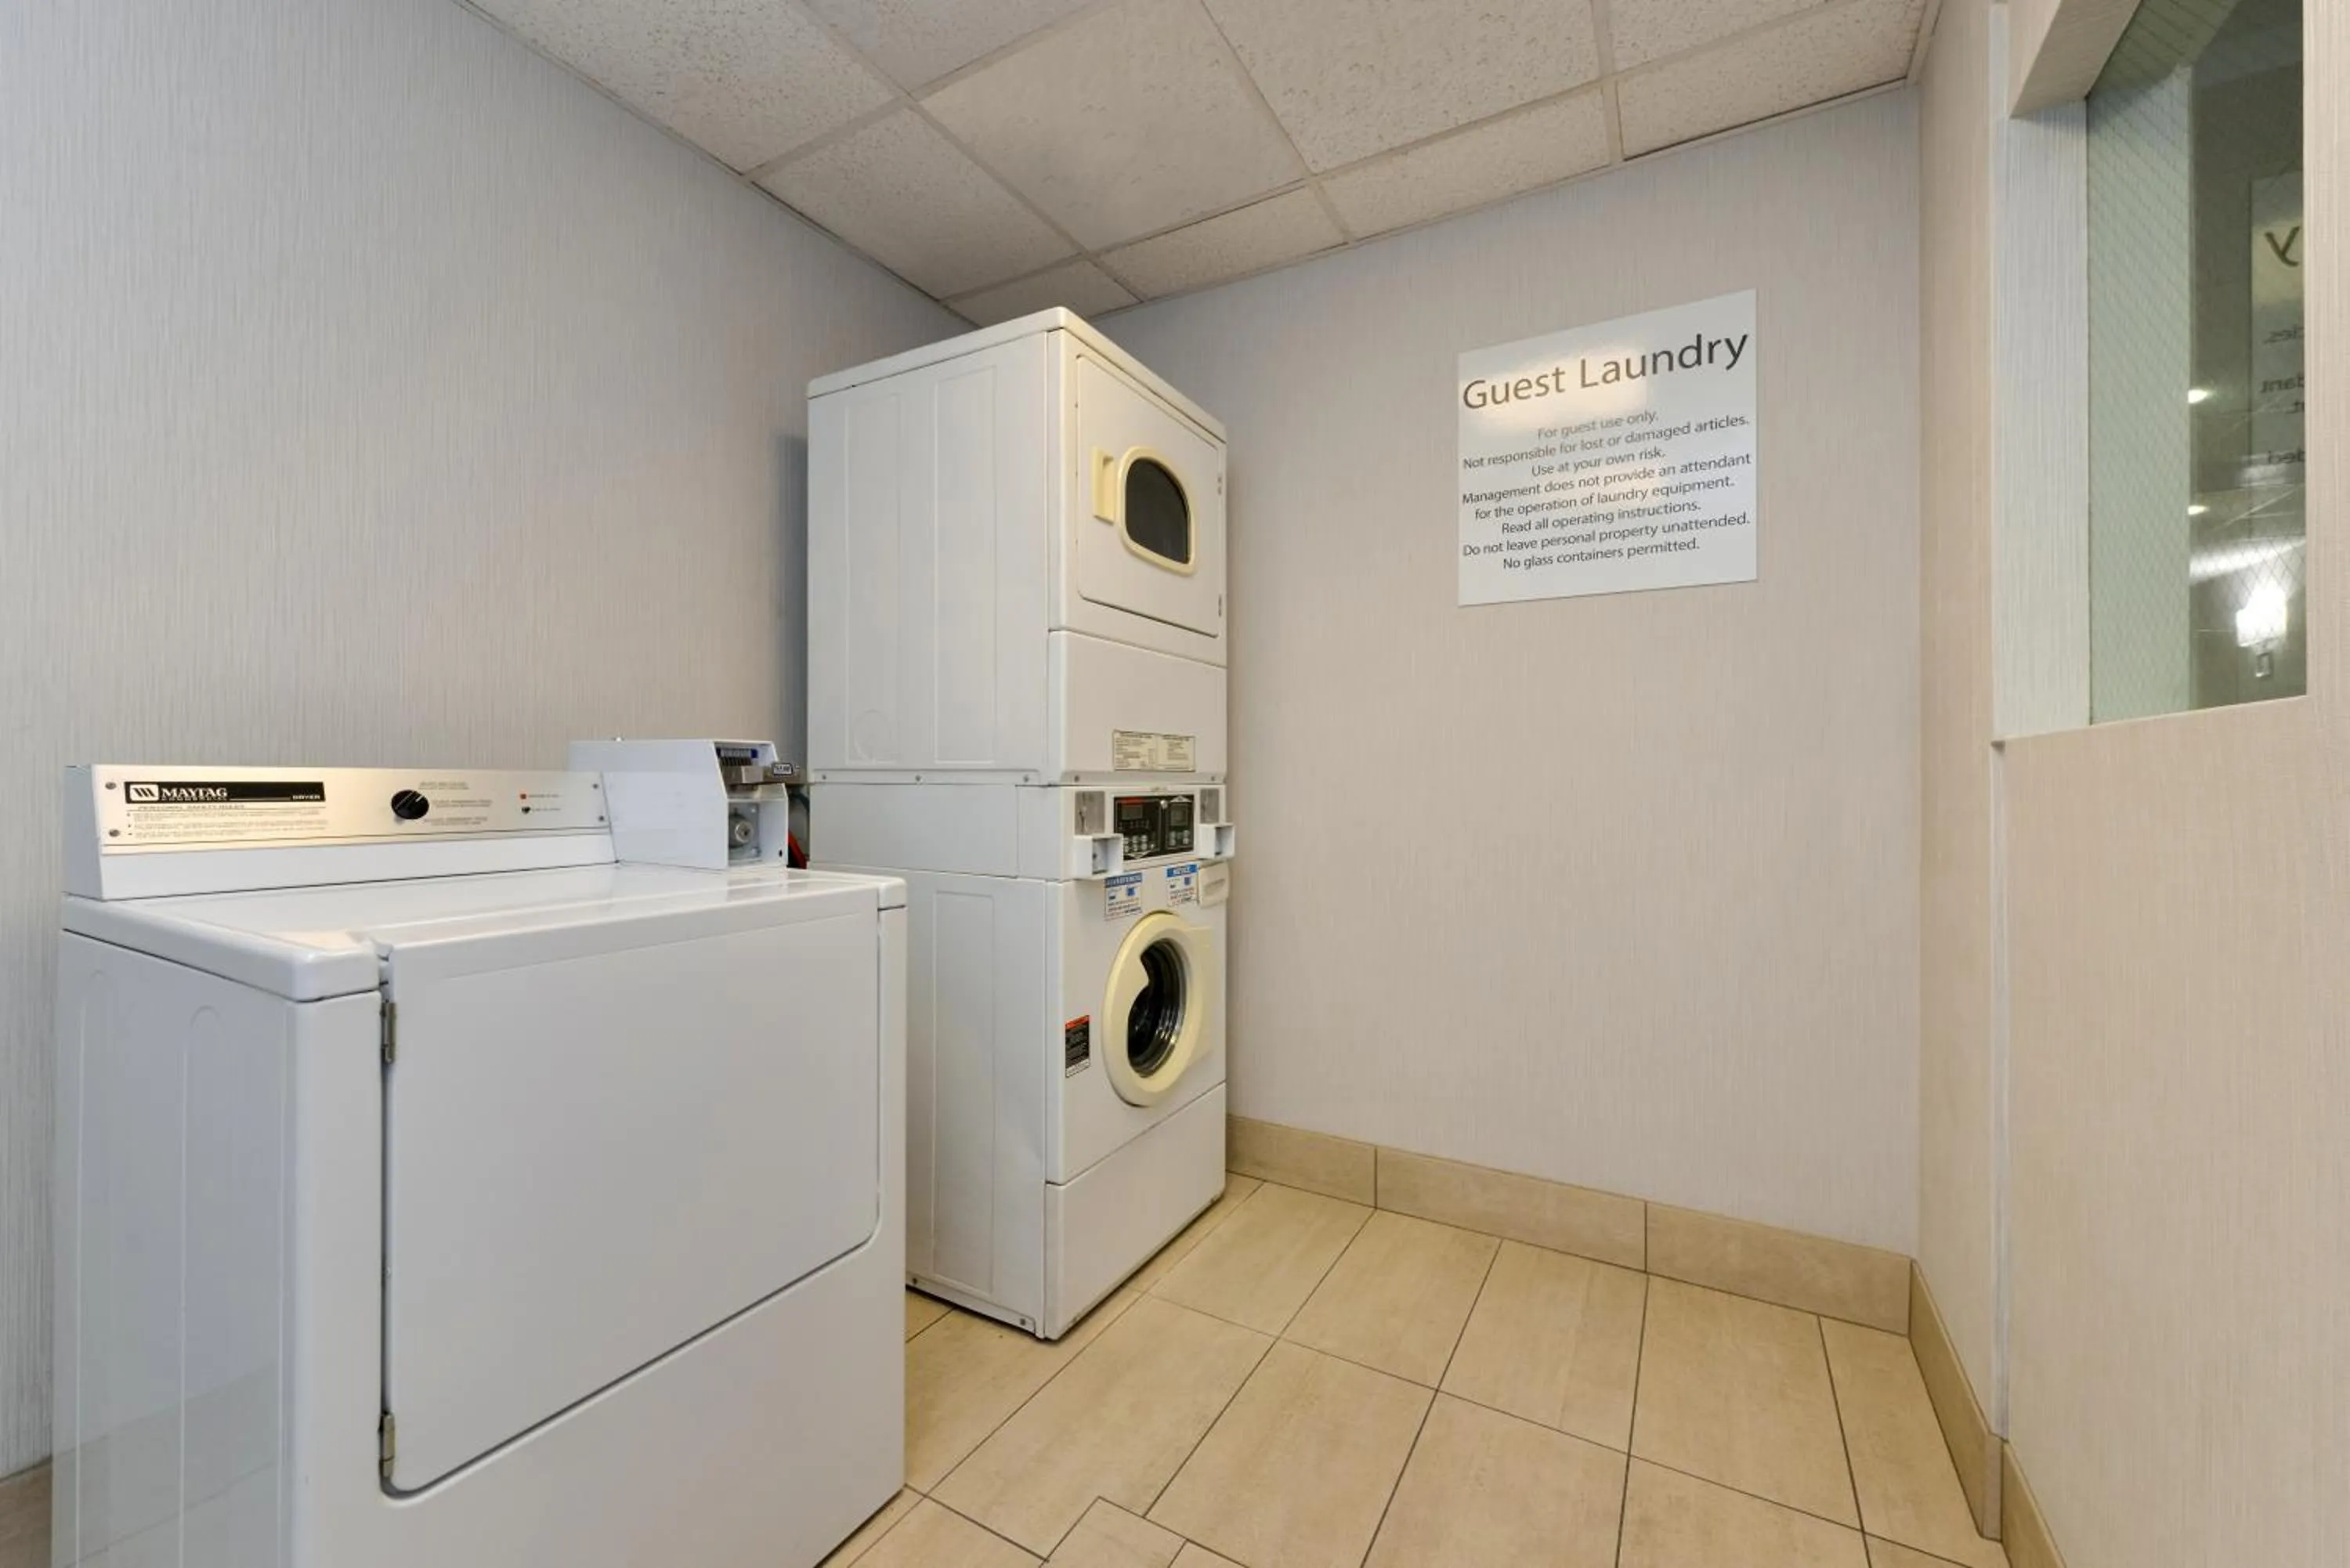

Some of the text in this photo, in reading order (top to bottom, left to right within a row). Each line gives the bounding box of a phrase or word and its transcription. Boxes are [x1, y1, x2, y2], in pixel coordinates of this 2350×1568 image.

[1462, 333, 1748, 410] Guest Laundry
[1462, 414, 1749, 469] Not responsible for lost or damaged articles.
[1538, 410, 1658, 439] For guest use only.
[1462, 453, 1752, 504] Management does not provide an attendant
[1531, 446, 1666, 477] Use at your own risk.
[1475, 476, 1735, 520] for the operation of laundry equipment.
[1502, 500, 1701, 534] Read all operating instructions.
[1462, 511, 1751, 557] Do not leave personal property unattended.
[1503, 537, 1701, 570] No glass containers permitted.
[161, 787, 227, 797] MAYTAG
